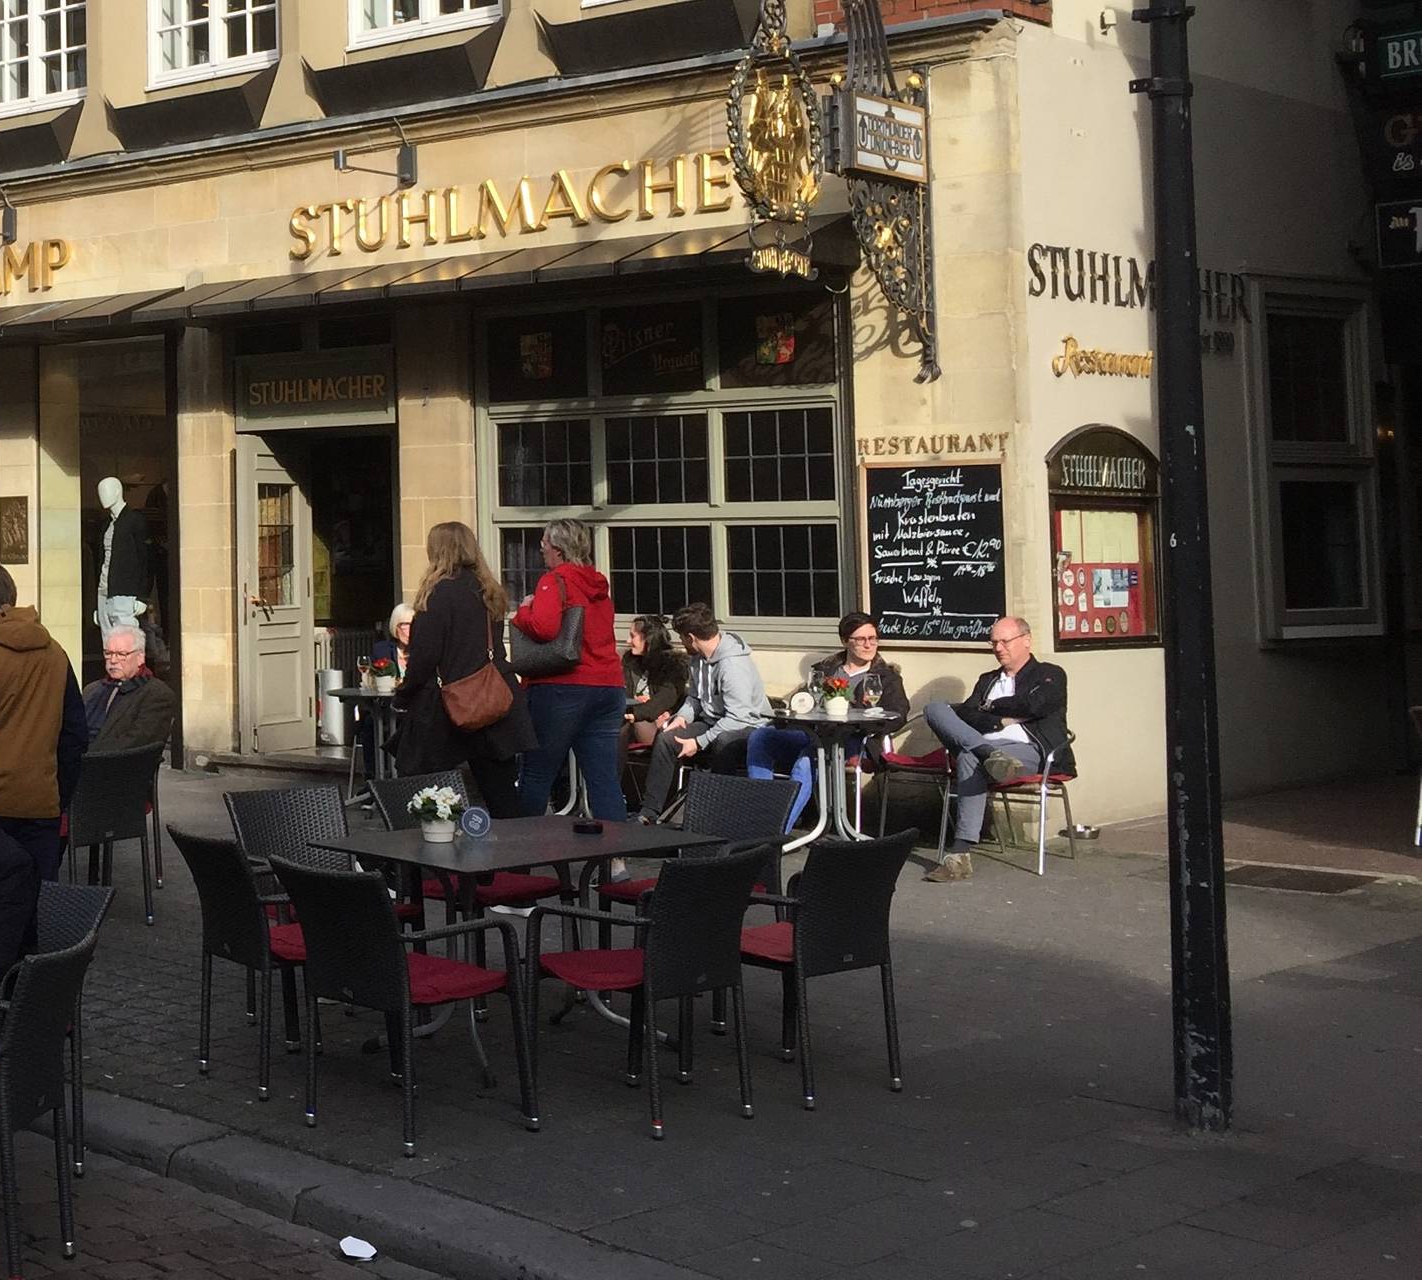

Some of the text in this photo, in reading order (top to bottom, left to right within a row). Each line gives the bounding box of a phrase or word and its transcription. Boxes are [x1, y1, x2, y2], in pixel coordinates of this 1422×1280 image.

[1028, 243, 1252, 324] STUHLMHER
[249, 374, 386, 406] STUHLMACHER
[857, 432, 1009, 456] RESTAURANT
[902, 468, 964, 492] Tagesgericht
[1061, 454, 1146, 489] STUHLMACHER
[873, 521, 889, 541] mit
[1170, 533, 1177, 547] 6
[925, 541, 934, 555] &
[902, 586, 942, 608] Waffeln
[903, 619, 919, 635] bis
